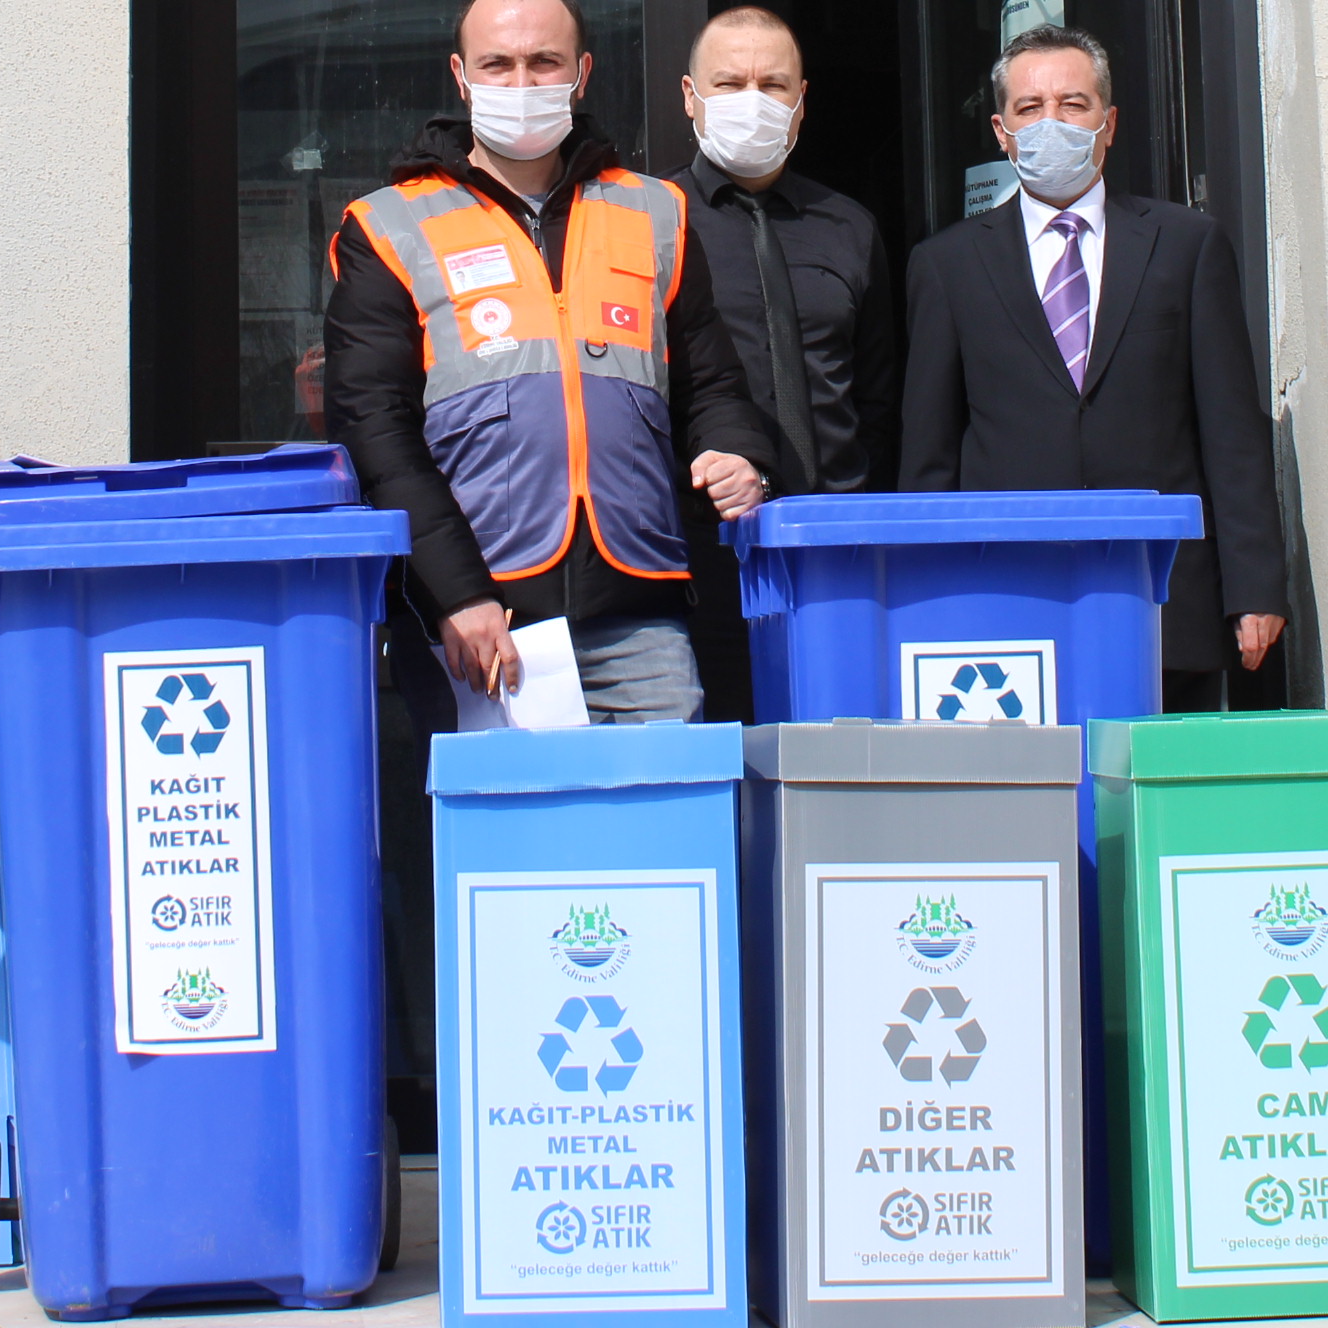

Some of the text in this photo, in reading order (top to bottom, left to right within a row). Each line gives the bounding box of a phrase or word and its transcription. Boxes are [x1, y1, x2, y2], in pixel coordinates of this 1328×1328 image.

[150, 773, 225, 795] KAĞIT
[137, 799, 240, 823] PLASTİK
[149, 829, 229, 848] METAL
[140, 856, 240, 877] ATIKLAR
[190, 895, 232, 911] SIFIR
[191, 911, 232, 928] ATIK
[488, 1099, 695, 1127] KAĞIT-PLASTİK
[879, 1100, 993, 1132] DİĞER
[547, 1134, 637, 1155] METAL
[855, 1146, 1016, 1174] ATIKLAR
[511, 1163, 675, 1192] ATIKLAR
[934, 1191, 993, 1213] SIFIR
[591, 1204, 651, 1224] SIFIR
[935, 1214, 993, 1236] ATIK
[592, 1226, 651, 1249] ATIK
[929, 1248, 970, 1265] değer
[586, 1260, 627, 1277] değer
